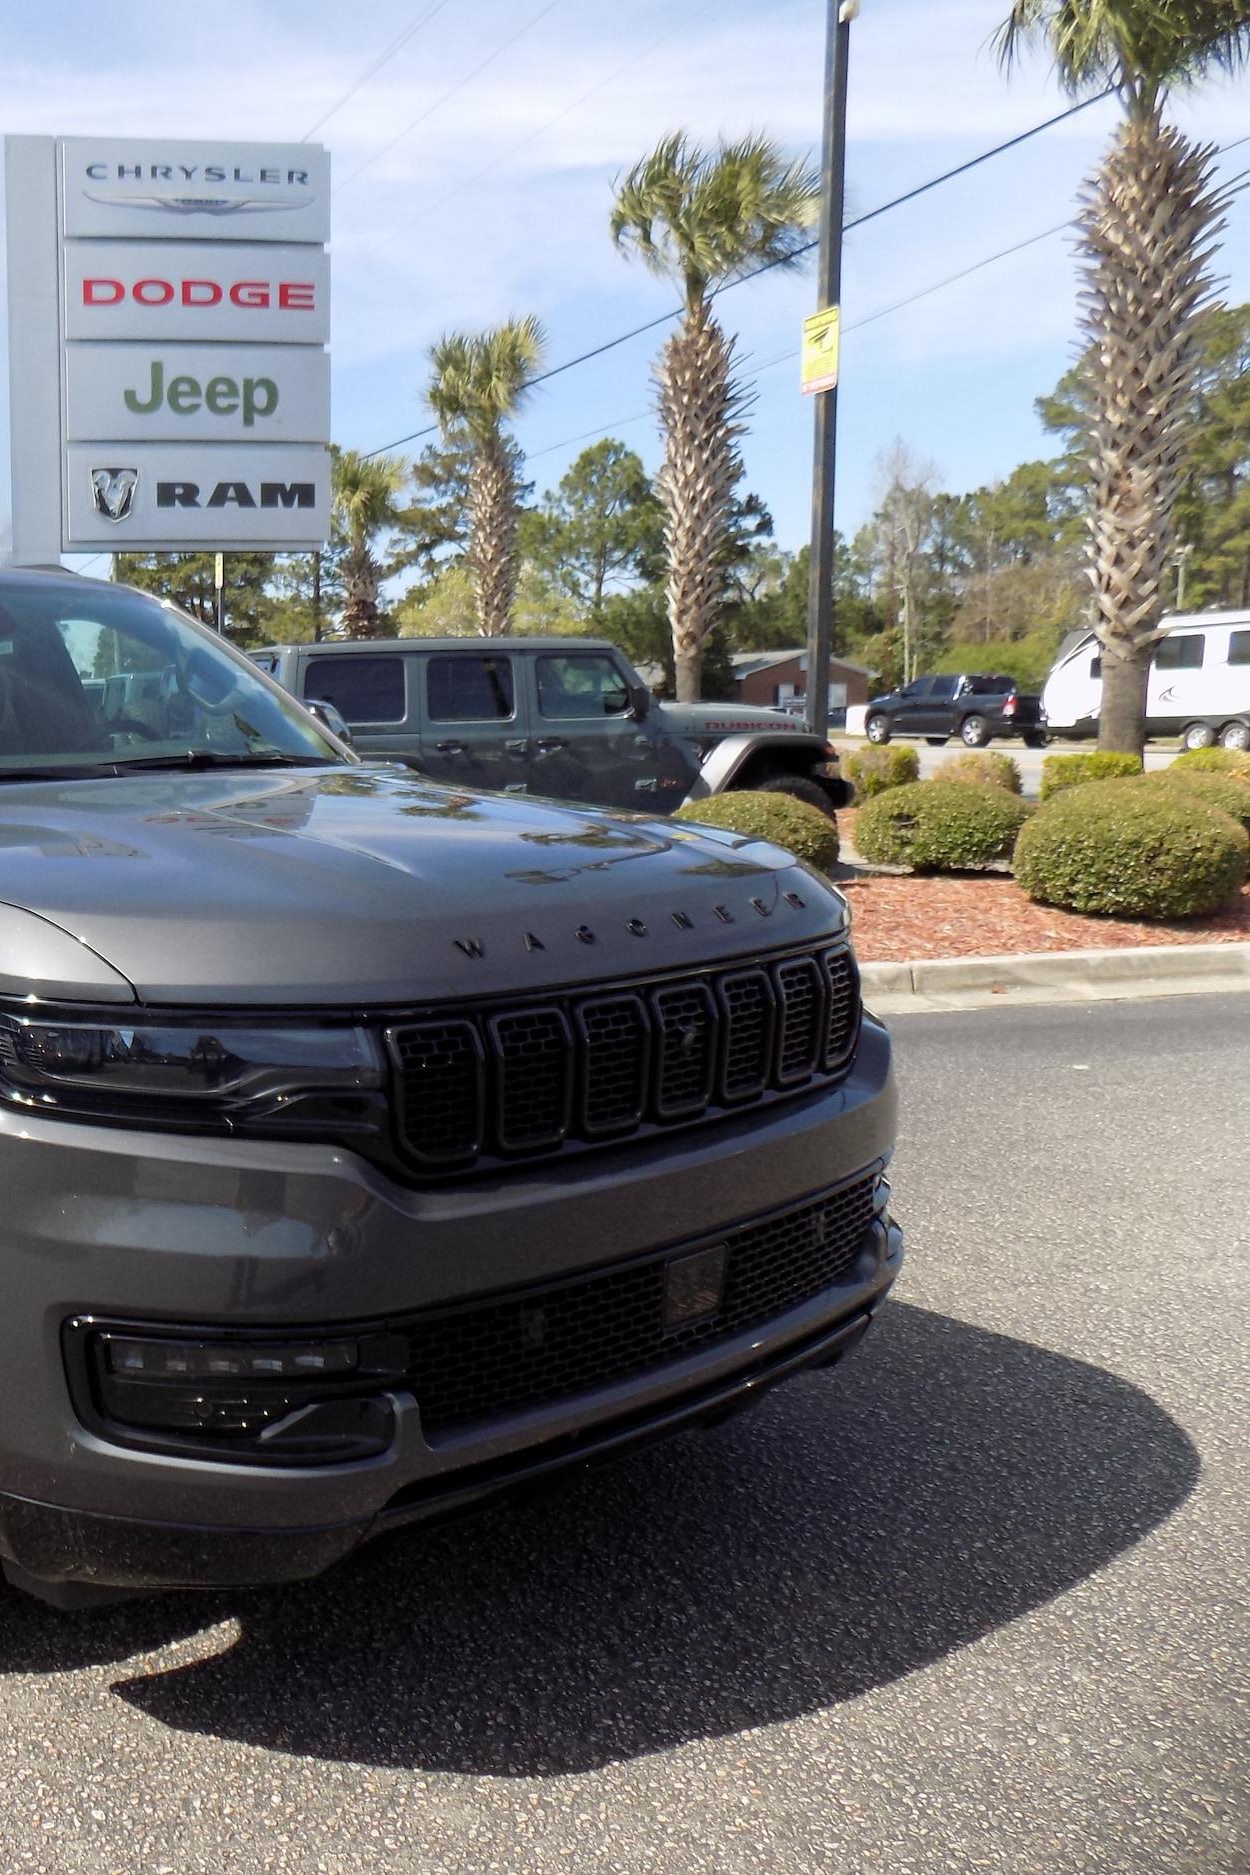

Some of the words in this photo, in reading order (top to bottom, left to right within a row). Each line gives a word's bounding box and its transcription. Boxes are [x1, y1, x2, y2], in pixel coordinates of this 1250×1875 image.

[85, 163, 309, 187] CHRYSLER
[82, 278, 316, 311] DODGE
[123, 361, 279, 427] Jeep
[155, 481, 316, 510] RAM
[704, 721, 797, 731] RUBICON
[453, 892, 806, 960] WAGONEER
